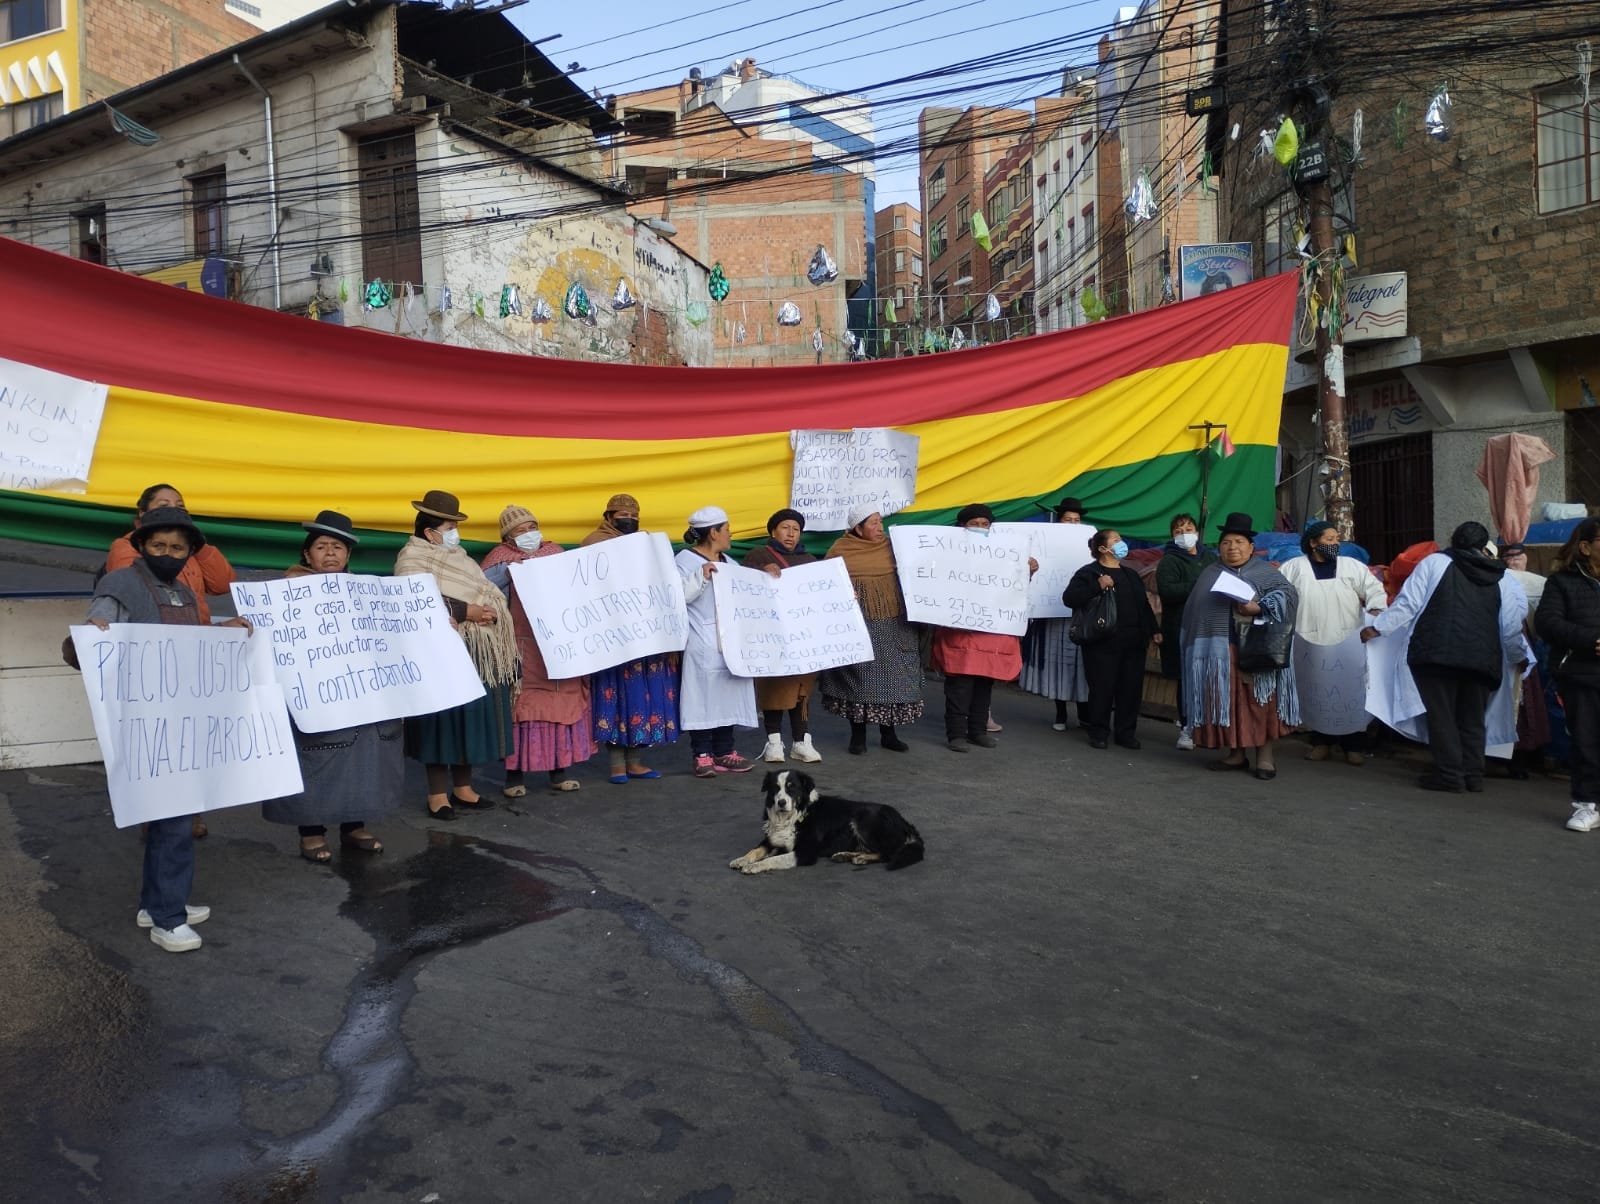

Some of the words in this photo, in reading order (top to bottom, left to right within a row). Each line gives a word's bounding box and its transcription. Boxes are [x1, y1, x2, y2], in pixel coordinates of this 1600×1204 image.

[1298, 153, 1323, 170] 22B
[1372, 382, 1422, 410] BELLE
[918, 534, 1020, 562] EXIGIMOS
[571, 551, 609, 587] NO
[916, 567, 937, 579] EL
[948, 569, 1025, 592] ACUERDO
[237, 585, 255, 608] No
[262, 588, 272, 607] al
[283, 580, 313, 602] alza
[320, 574, 341, 595] del
[347, 577, 379, 599] precio
[408, 577, 426, 594] las
[283, 600, 302, 621] de
[353, 598, 364, 612] el
[370, 598, 401, 617] precio
[405, 595, 437, 613] sube
[787, 605, 816, 619] STA
[913, 594, 941, 608] DEL
[971, 602, 993, 618] DE
[272, 622, 307, 647] culpa
[318, 615, 341, 636] del
[351, 614, 419, 634] contrabando
[425, 615, 432, 630] y
[553, 640, 578, 664] DE
[583, 622, 648, 655] CARNE
[744, 627, 813, 646] CUMPLAN
[272, 646, 296, 667] los
[307, 634, 388, 669] productores
[740, 649, 771, 661] LOS
[779, 642, 865, 660] ACUERDOS
[93, 638, 179, 702] PRECIO
[190, 639, 251, 698] JUSTO
[292, 671, 308, 712] al
[318, 654, 423, 705] contrabando
[747, 664, 775, 675] DEL
[179, 716, 201, 772] EL
